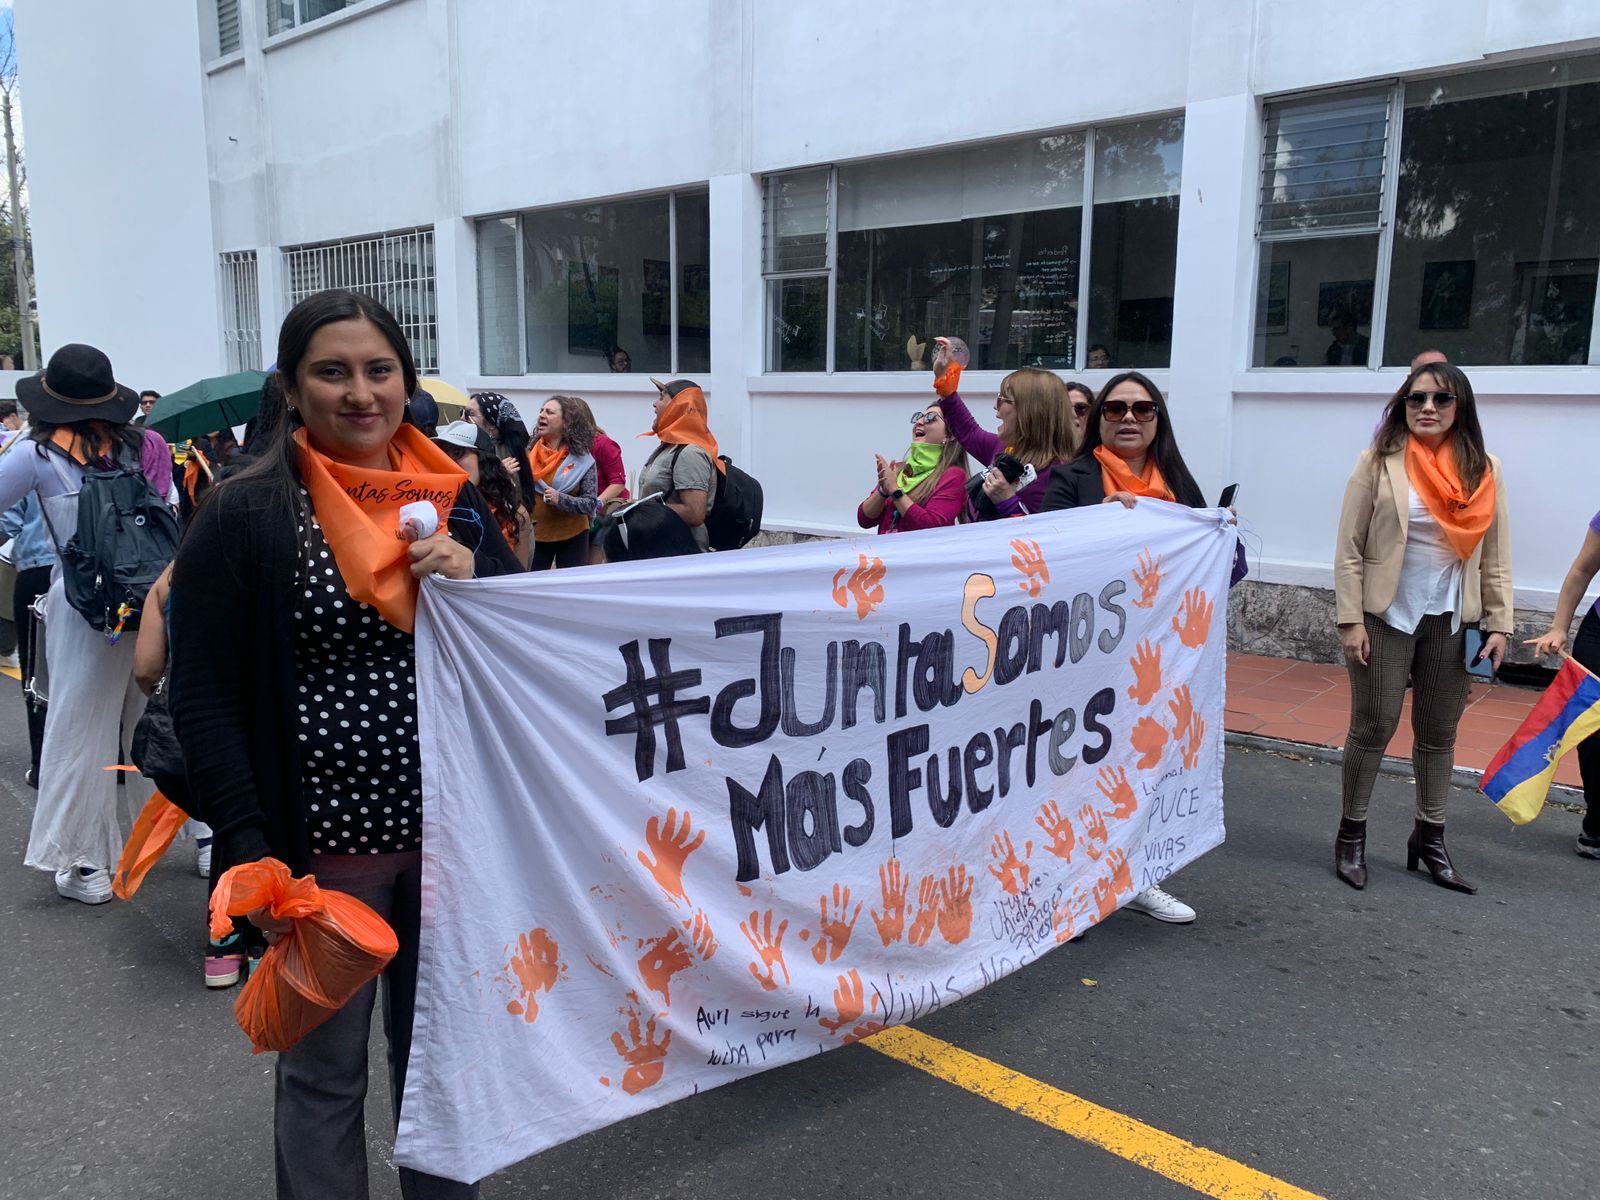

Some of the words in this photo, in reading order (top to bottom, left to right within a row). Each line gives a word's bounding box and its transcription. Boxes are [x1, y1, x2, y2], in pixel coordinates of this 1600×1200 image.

[340, 479, 389, 504] ntas
[391, 479, 453, 508] Somos
[726, 746, 876, 882] Más
[887, 688, 1116, 839] Fuertes
[1147, 787, 1200, 833] PUCE
[1142, 862, 1173, 886] NOS
